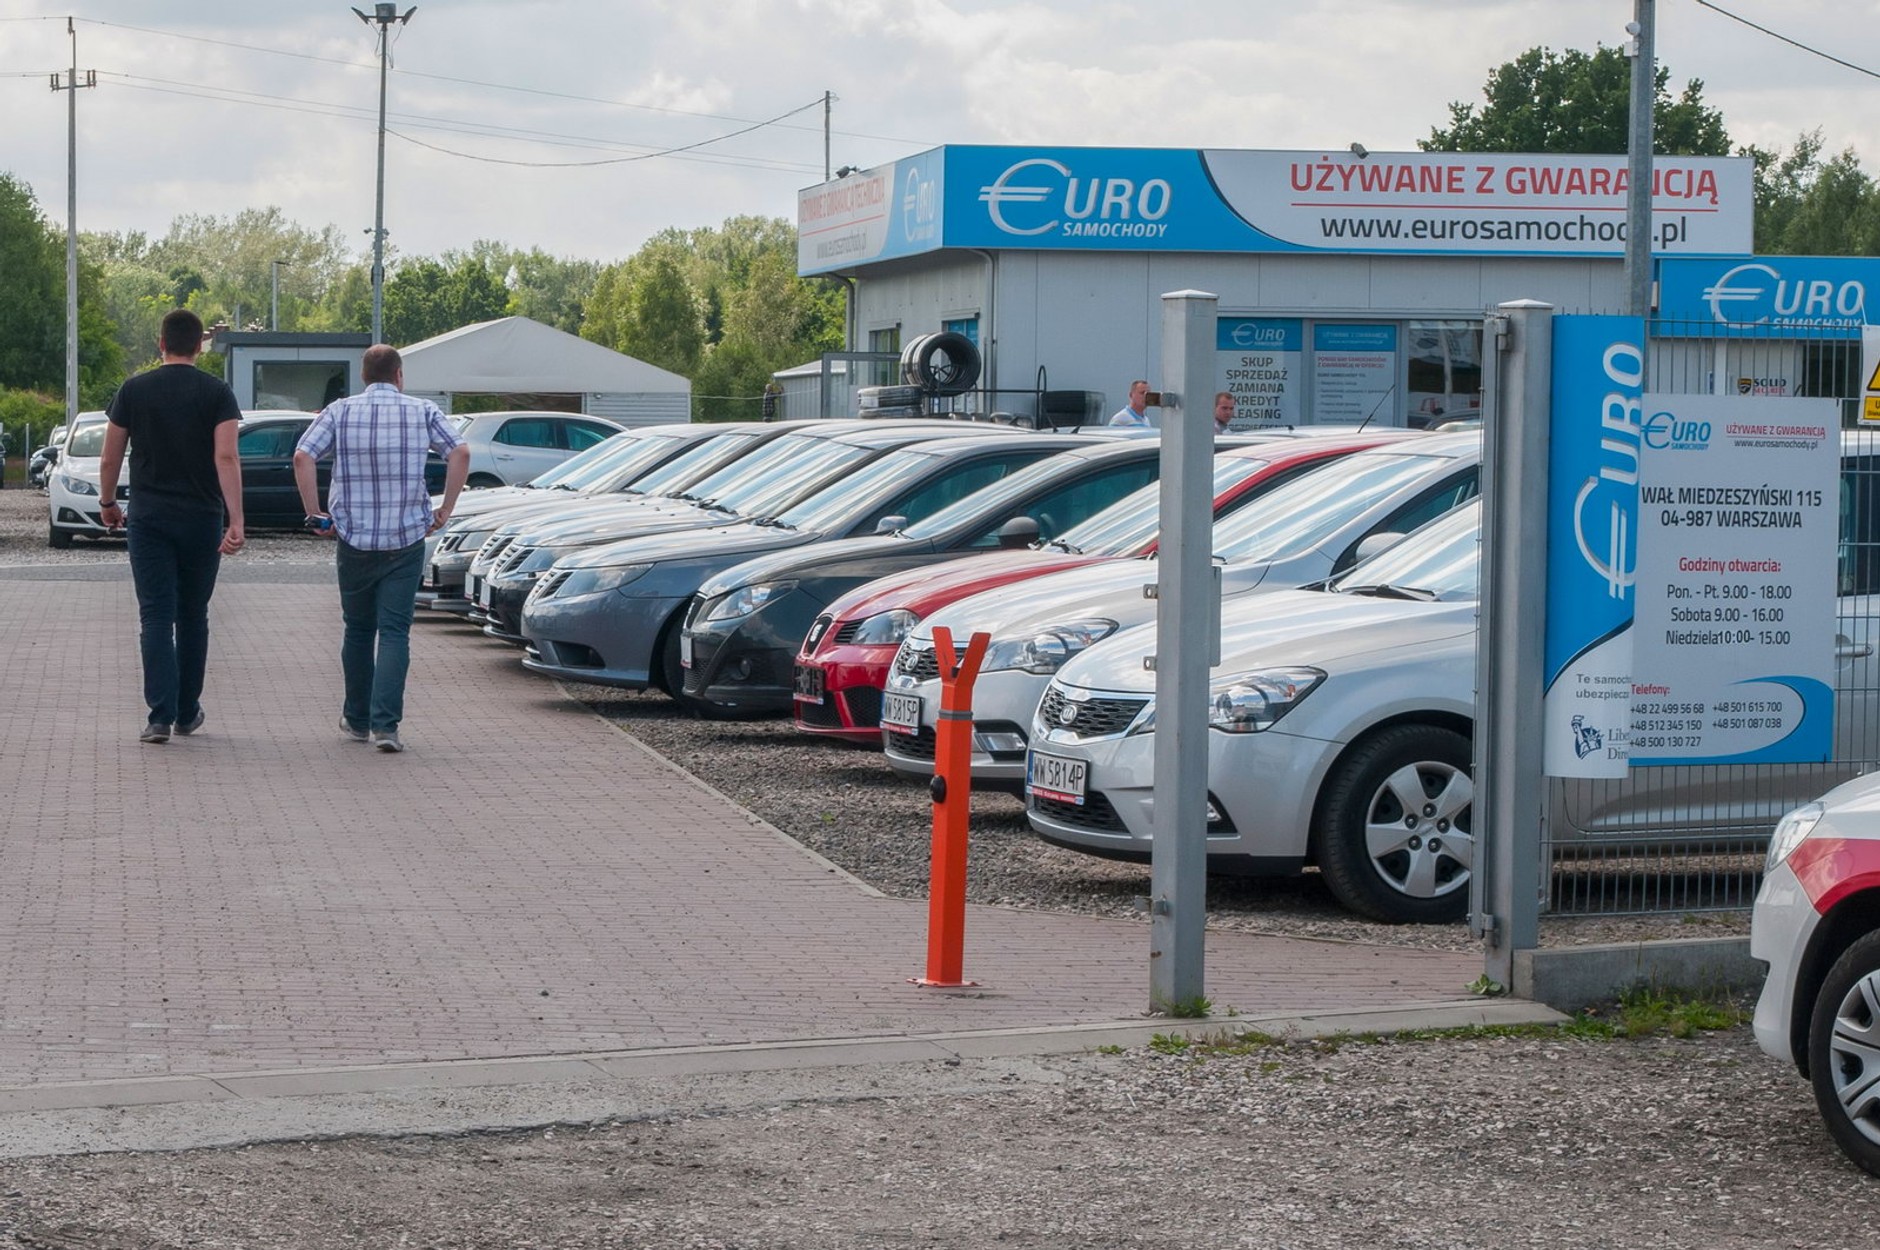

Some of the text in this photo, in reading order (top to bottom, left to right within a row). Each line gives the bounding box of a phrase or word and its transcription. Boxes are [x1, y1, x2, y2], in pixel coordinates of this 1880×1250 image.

[1291, 155, 1465, 193] UŻYWANE
[1476, 166, 1495, 194] Z
[1062, 222, 1168, 238] SAMOCHODY
[1241, 357, 1274, 367] SKUP
[1226, 367, 1288, 381] SPRZEDAŻ
[1229, 383, 1285, 393] ZAMIANA
[1233, 396, 1281, 406] KREDYT
[1726, 422, 1826, 440] UŻYWANE Z GWARANCJĄ
[1671, 442, 1709, 451] SAMOCHODY
[1734, 439, 1818, 450] www.eurosamochody.pl
[1642, 484, 1822, 507] WAŁ MIEDZESZYŃSKI 115
[1661, 510, 1802, 528] 04-987 WARSZAWA
[1679, 557, 1782, 575] Godziny otwarcia:
[1667, 584, 1692, 599] Pon.
[1704, 584, 1719, 599] Pt.
[1722, 585, 1748, 599] 9.00
[1760, 585, 1792, 599] 18.00
[1671, 607, 1711, 622] Sobota
[1714, 608, 1740, 622] 9.00
[1752, 608, 1784, 622] 16.00
[1759, 631, 1790, 645] 15.00
[1576, 673, 1590, 684] Te
[1631, 684, 1671, 697] Telefony:
[893, 698, 917, 723] 5815P
[1630, 703, 1704, 714] +48 22 499 56 68
[1712, 702, 1782, 712] +48 501 615 700
[1630, 720, 1702, 731] +48 512 345 150
[1712, 718, 1782, 729] +48 501 087 038
[1629, 737, 1701, 747] +48 500 130 727
[1048, 760, 1084, 791] 5814P
